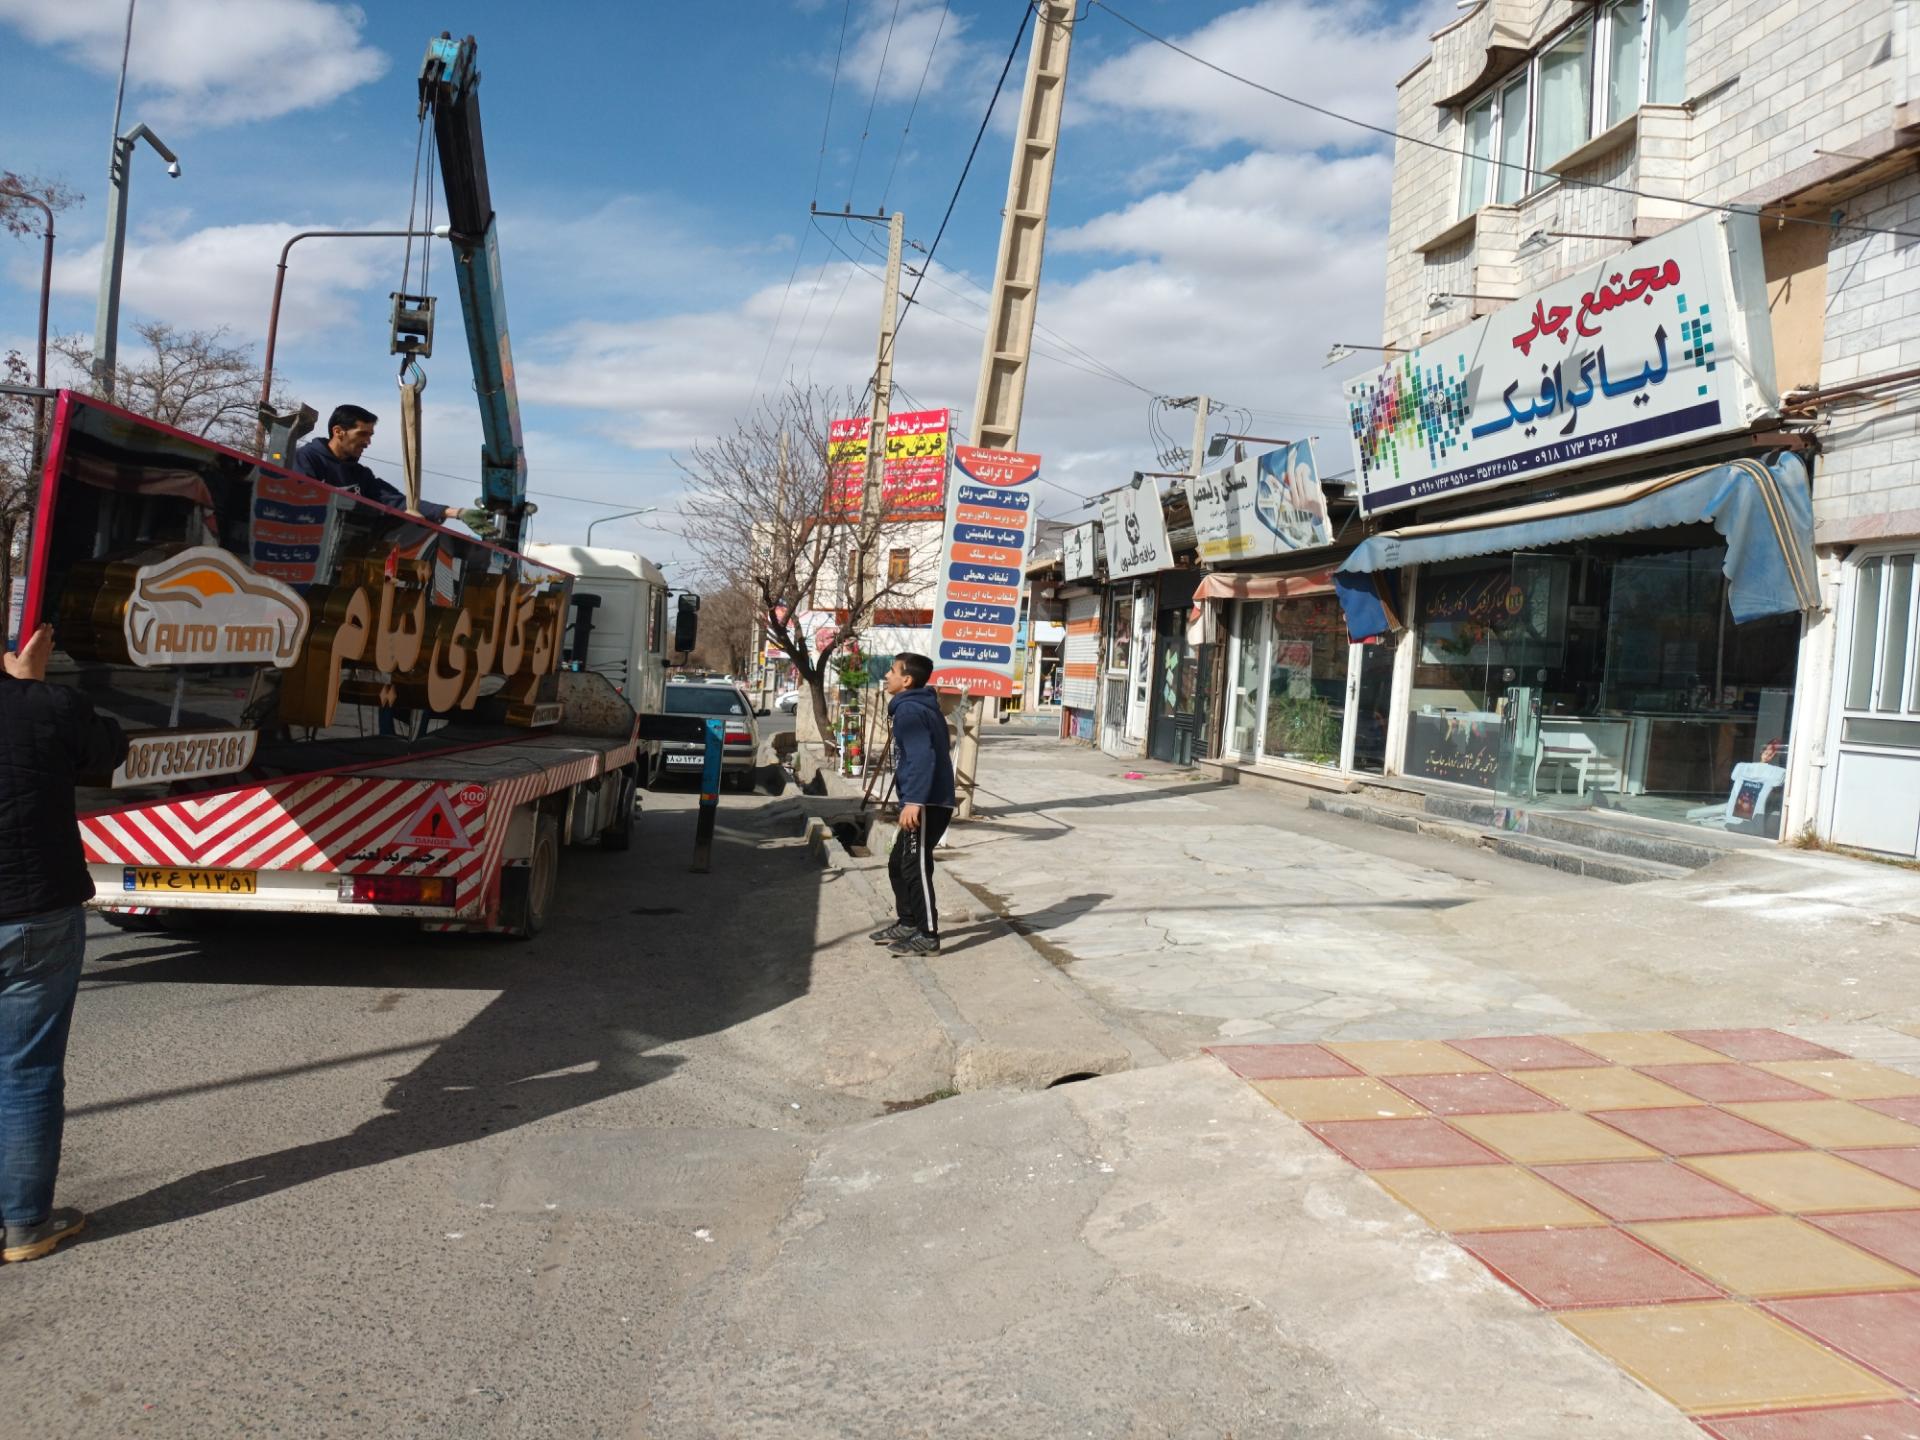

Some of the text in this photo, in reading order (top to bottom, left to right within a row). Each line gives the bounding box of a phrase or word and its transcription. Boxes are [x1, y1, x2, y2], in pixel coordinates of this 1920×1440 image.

[1512, 258, 1680, 356] مجتمع چاپ
[1472, 324, 1668, 437] لیا گرافیک
[906, 433, 942, 457] فرش
[975, 465, 1002, 481] گرافیک
[1221, 471, 1248, 502] مسکن
[1014, 493, 1029, 506] چاپ
[997, 531, 1016, 544] چاپ
[988, 551, 1006, 563] چاپ
[963, 569, 1009, 584] تبلیغات محیطی
[953, 606, 977, 619] لیزری
[155, 624, 218, 653] AUTO
[951, 646, 975, 658] تبلیغاتی
[126, 735, 248, 780] 08735275181
[462, 791, 485, 802] 100
[415, 837, 451, 847] DANGER
